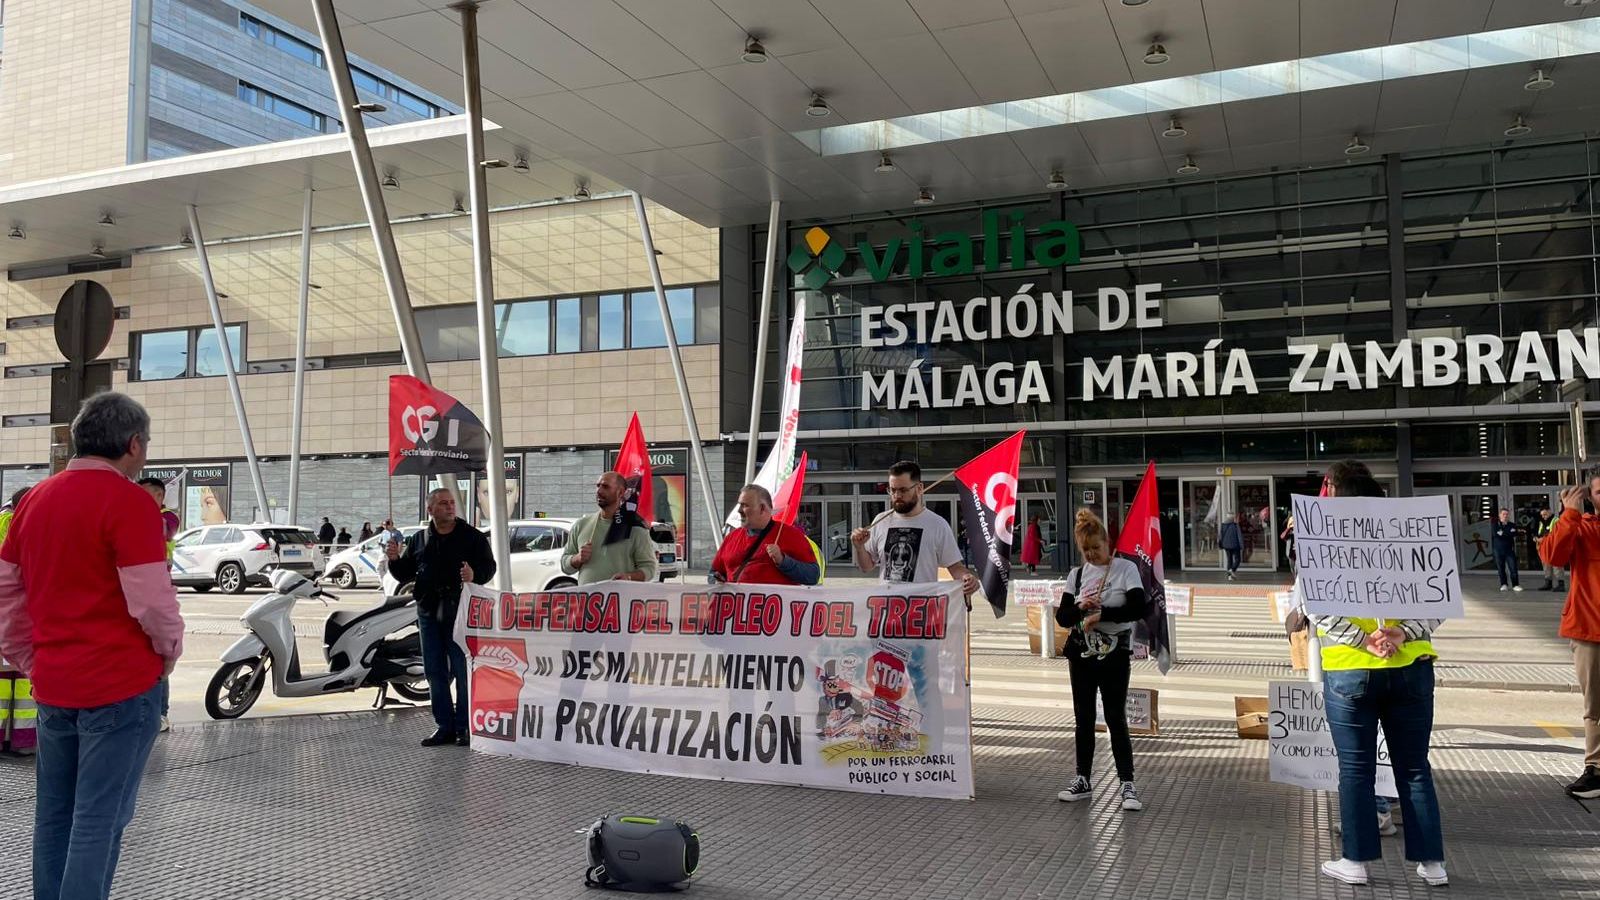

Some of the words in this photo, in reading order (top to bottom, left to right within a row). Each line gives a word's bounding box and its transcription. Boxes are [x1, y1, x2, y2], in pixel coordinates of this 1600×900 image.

[858, 209, 1081, 281] vialia
[861, 283, 1074, 347] ESTACIÓN
[1098, 283, 1163, 331] DE
[861, 359, 1051, 411] MÁLAGA
[1082, 338, 1259, 401] MARÍA
[193, 470, 222, 478] PRIMOR
[972, 483, 982, 512] Sector
[978, 511, 995, 546] Federal
[1294, 500, 1323, 536] NO
[1325, 515, 1350, 538] FUE
[1353, 517, 1385, 539] MALA
[1389, 516, 1448, 538] SUERTE
[1298, 542, 1317, 569] LA
[1320, 543, 1403, 572] PREVENCIÓN
[1412, 545, 1443, 572] NO
[1347, 580, 1362, 604] EL
[1424, 569, 1454, 603] SÍ
[467, 595, 493, 630] EN
[499, 592, 621, 634] DEFENSA
[628, 600, 672, 634] DEL
[679, 592, 782, 636] EMPLEO
[790, 600, 809, 636] Y
[810, 601, 857, 637] DEL
[867, 594, 949, 640] TREN
[534, 656, 553, 677] NI
[559, 649, 805, 692] DESMANTELAMIENTO
[873, 661, 905, 692] STOP
[1278, 685, 1324, 710] HEMO
[472, 709, 513, 736] CGT
[521, 704, 544, 739] NI
[555, 698, 802, 765] PRIVATIZACIÓN
[1270, 711, 1289, 739] 3
[1288, 714, 1331, 732] HUELGA
[848, 757, 868, 767] POR
[872, 757, 886, 767] UN
[890, 754, 956, 767] FERROCARRIL
[1272, 743, 1280, 753] Y
[1282, 745, 1311, 758] COMO
[1314, 747, 1339, 758] RESU
[849, 770, 898, 784] PÚBLICO
[903, 772, 910, 783] Y
[915, 770, 957, 782] SOCIAL
